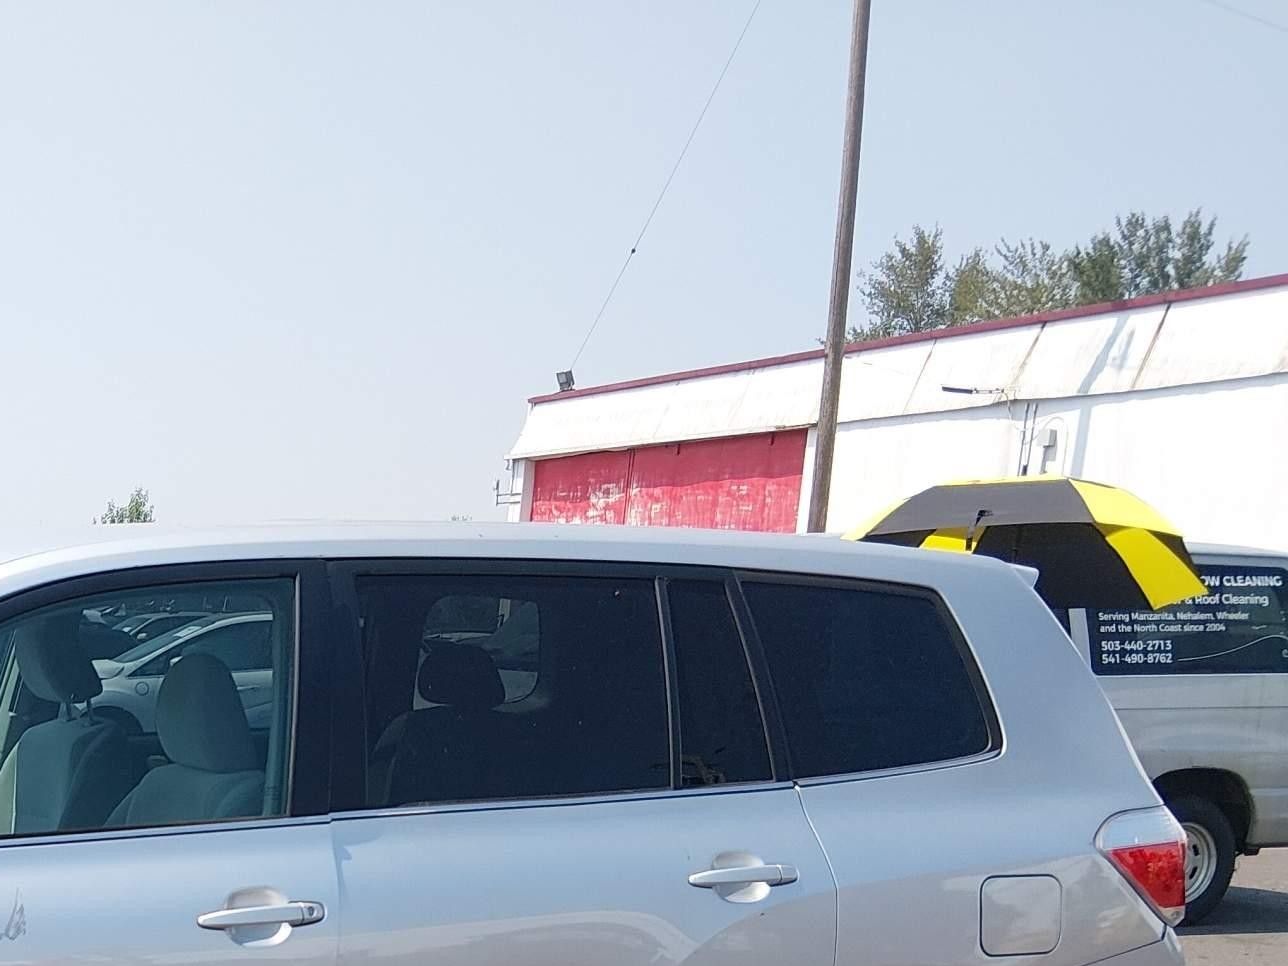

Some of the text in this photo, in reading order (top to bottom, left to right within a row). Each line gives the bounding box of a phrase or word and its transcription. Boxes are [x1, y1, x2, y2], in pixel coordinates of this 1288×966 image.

[1224, 576, 1282, 587] CLEANING
[1195, 594, 1220, 604] Roof
[1222, 594, 1268, 606] Cleaning
[1098, 612, 1130, 622] Serving
[1131, 612, 1175, 620] Manzanita,
[1216, 612, 1250, 620] Wheeler
[1100, 624, 1116, 632] and
[1118, 624, 1132, 632] the
[1134, 624, 1157, 632] North
[1158, 624, 1182, 632] Coast
[1184, 624, 1204, 632] since
[1101, 640, 1172, 651] 503-440-2713
[1102, 653, 1173, 664] 541-490-8762
